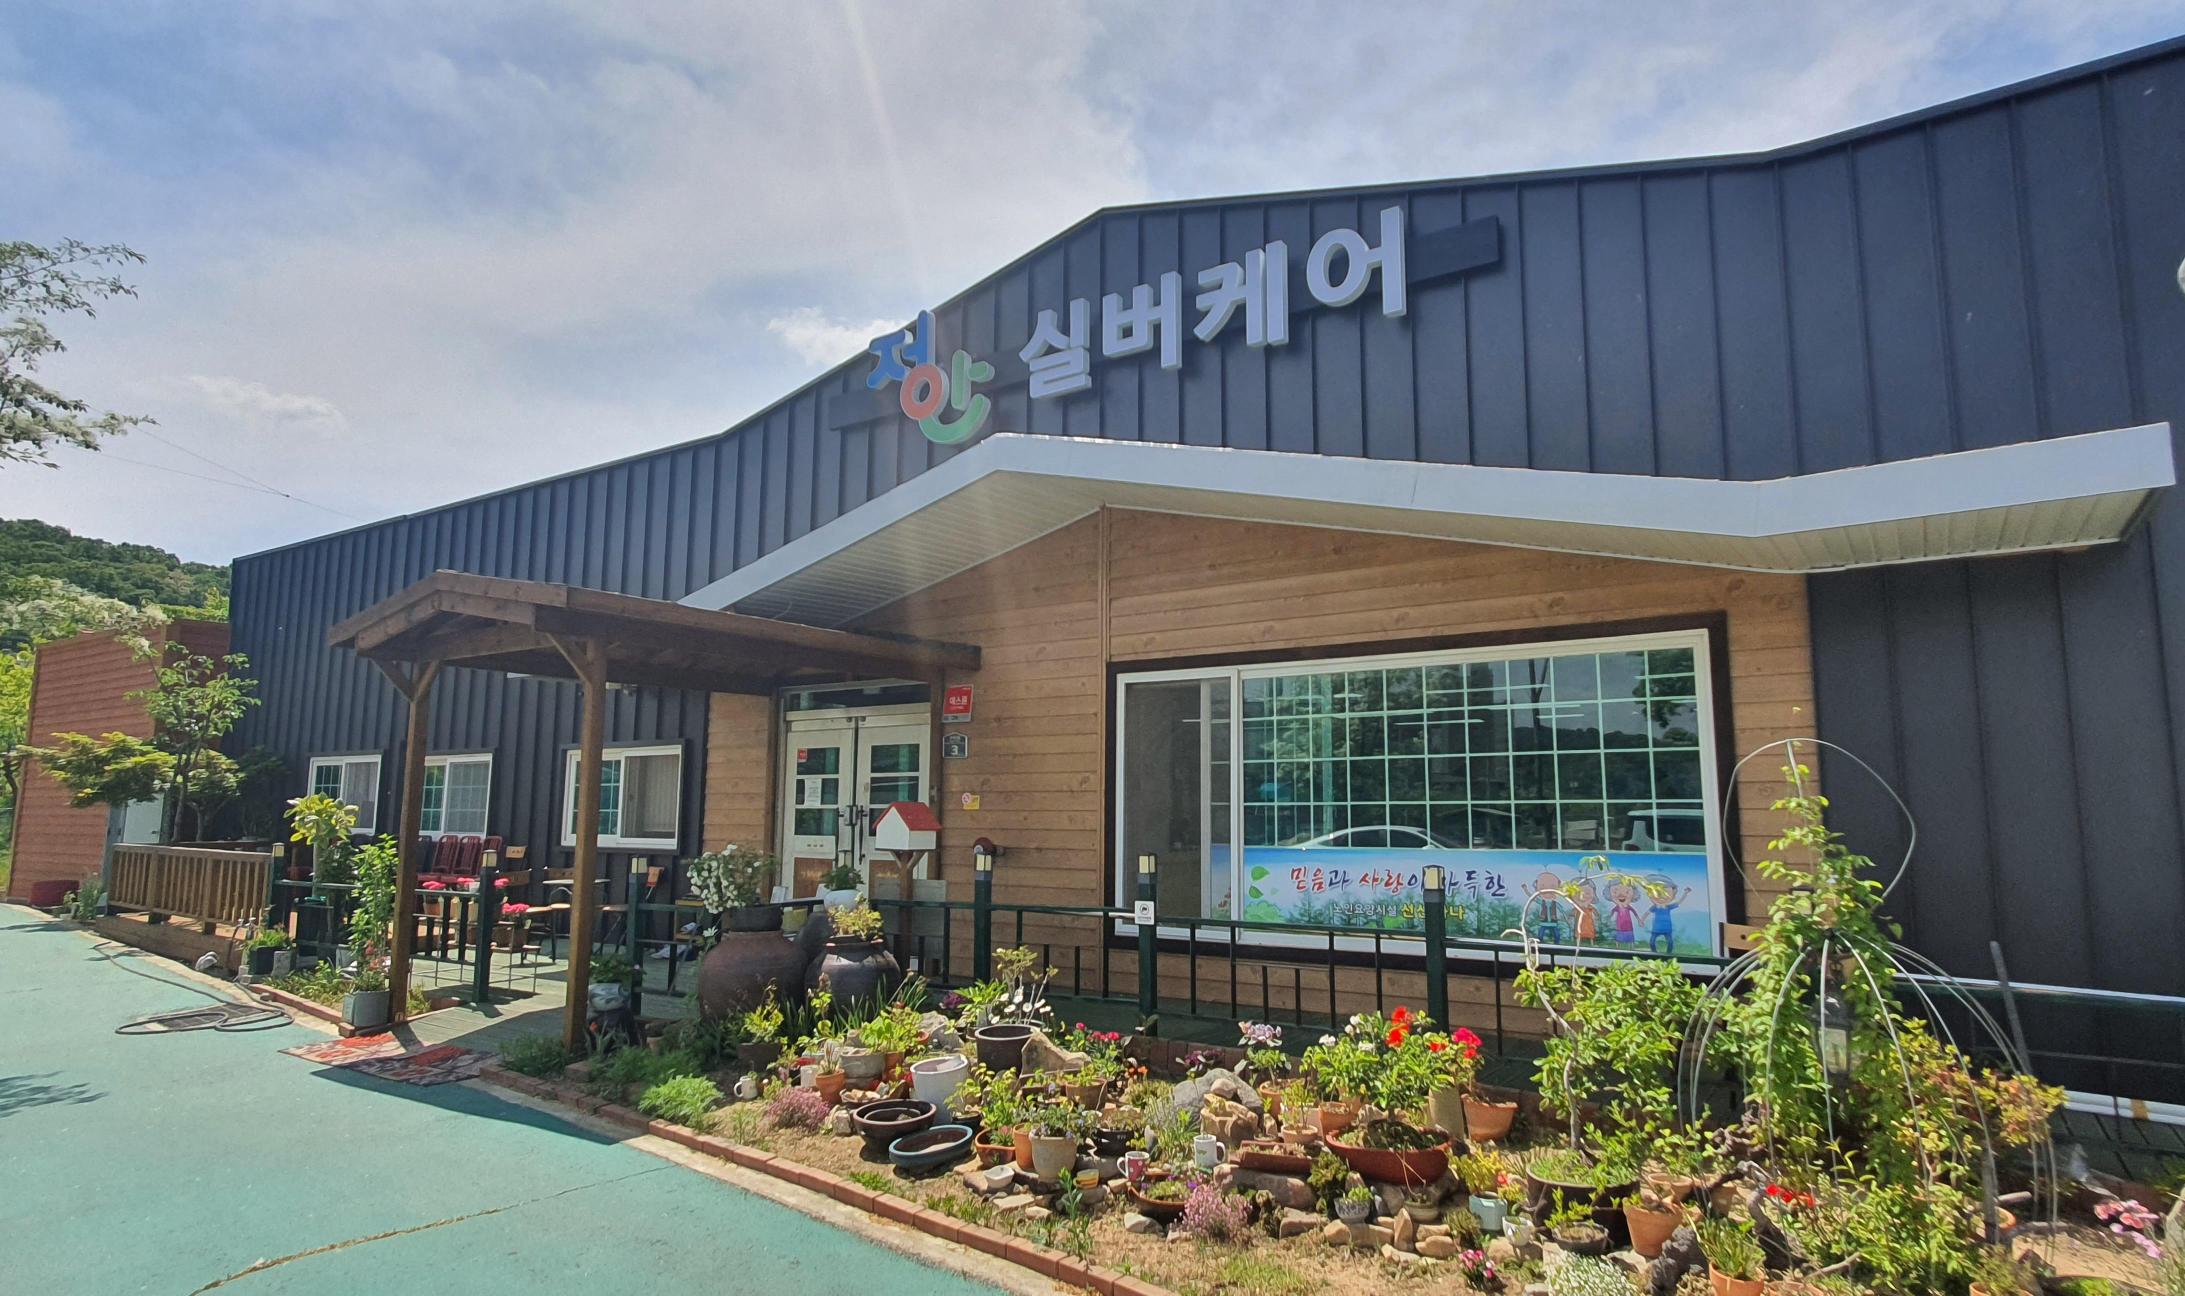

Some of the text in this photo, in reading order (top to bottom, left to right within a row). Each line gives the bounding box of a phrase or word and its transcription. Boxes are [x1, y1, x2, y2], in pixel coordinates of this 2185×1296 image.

[1018, 205, 1407, 400] 실버케어
[951, 745, 958, 755] 3
[1290, 866, 1350, 892] 믿음과
[1359, 868, 1424, 895] 사랑이
[1333, 903, 1397, 917] 노인요양시설
